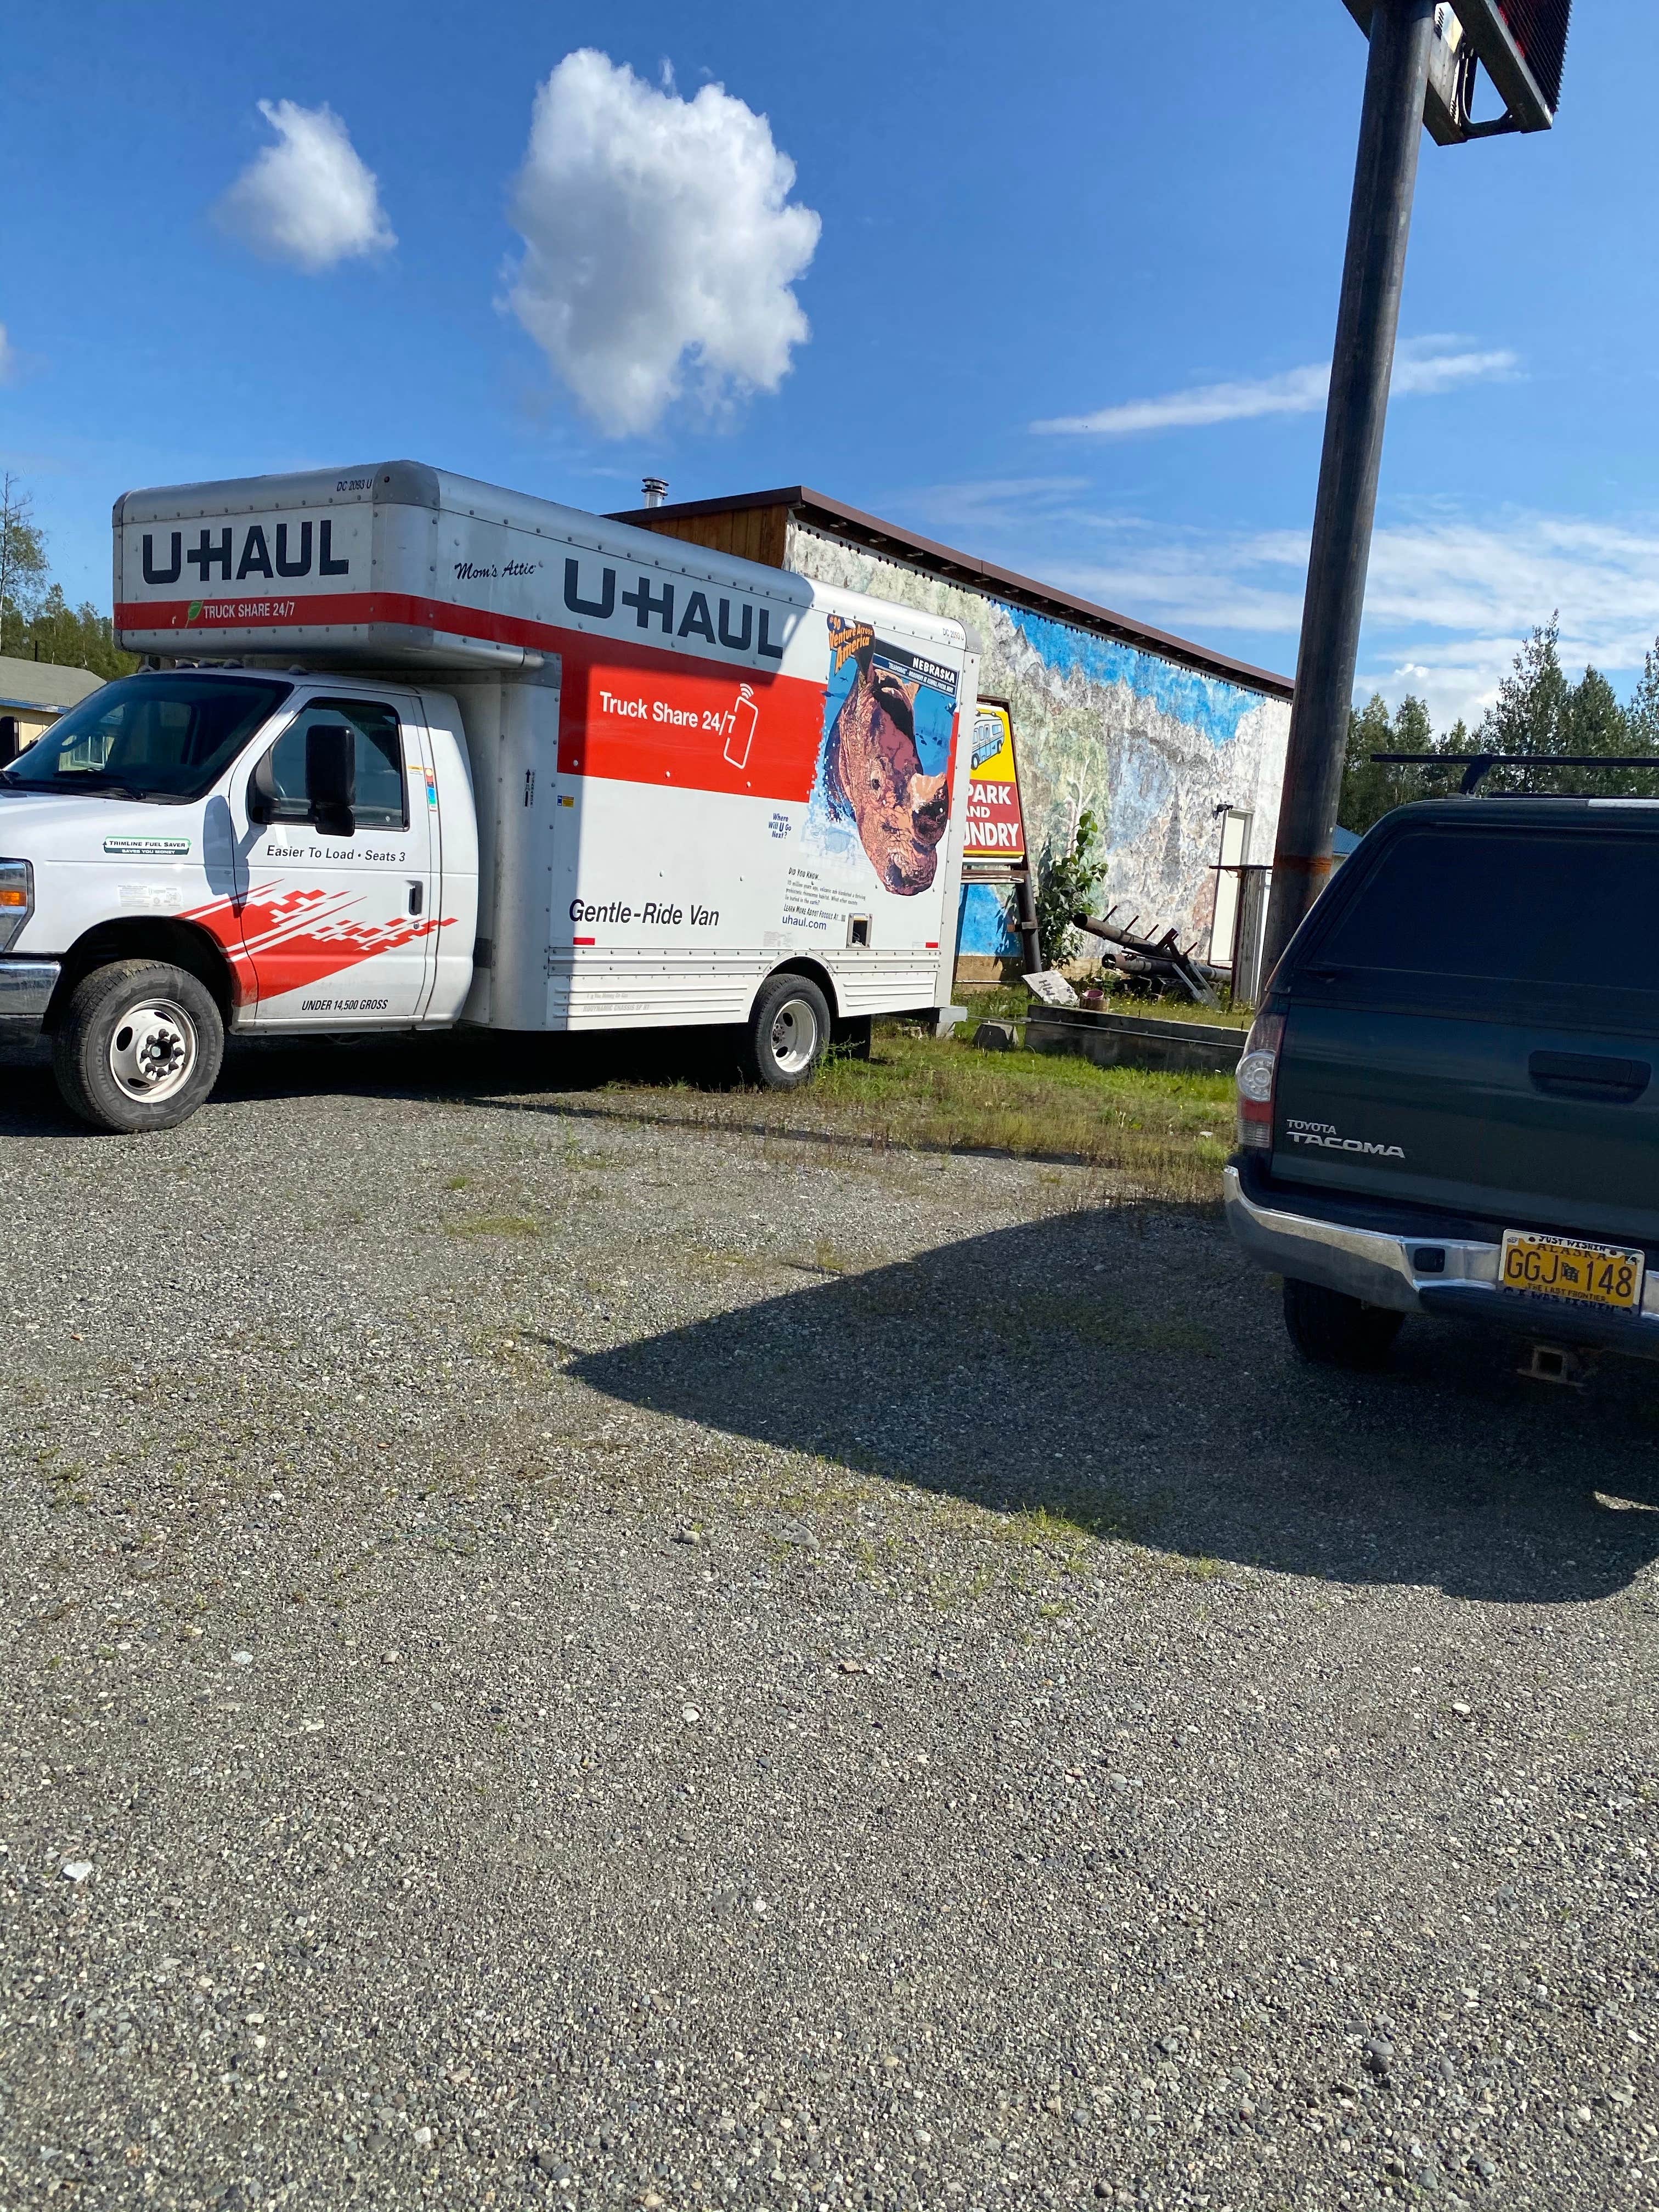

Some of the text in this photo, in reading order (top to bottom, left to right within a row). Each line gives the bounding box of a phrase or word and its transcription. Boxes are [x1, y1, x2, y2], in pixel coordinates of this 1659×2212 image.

[336, 481, 348, 492] DC
[366, 479, 373, 489] U
[454, 560, 535, 580] Mom's Attic
[204, 601, 295, 619] TRUCK SHARE 24/7
[829, 624, 873, 649] Venture Across
[836, 634, 871, 674] America
[912, 657, 955, 683] NEBRASKA
[600, 691, 736, 736] Truck Share 24/7
[968, 783, 1012, 805] PARK
[772, 812, 788, 822] Where
[768, 821, 778, 830] Will
[779, 822, 784, 832] U
[772, 830, 787, 839] Next?
[267, 845, 406, 862] Easier To Load Seats 3
[797, 868, 805, 878] YOU
[569, 899, 719, 926] Gentle-Ride Van
[782, 915, 827, 930] uhaul.com
[302, 1000, 388, 1011] UNDER 14,500 GROSS
[1286, 1119, 1336, 1135] TOYOTA
[1286, 1132, 1406, 1159] TACOMA
[1539, 1235, 1562, 1245] JUST
[1537, 1244, 1607, 1261] ALASKA
[1508, 1248, 1633, 1297] GGJ 148
[1568, 1290, 1606, 1302] FRONTIER
